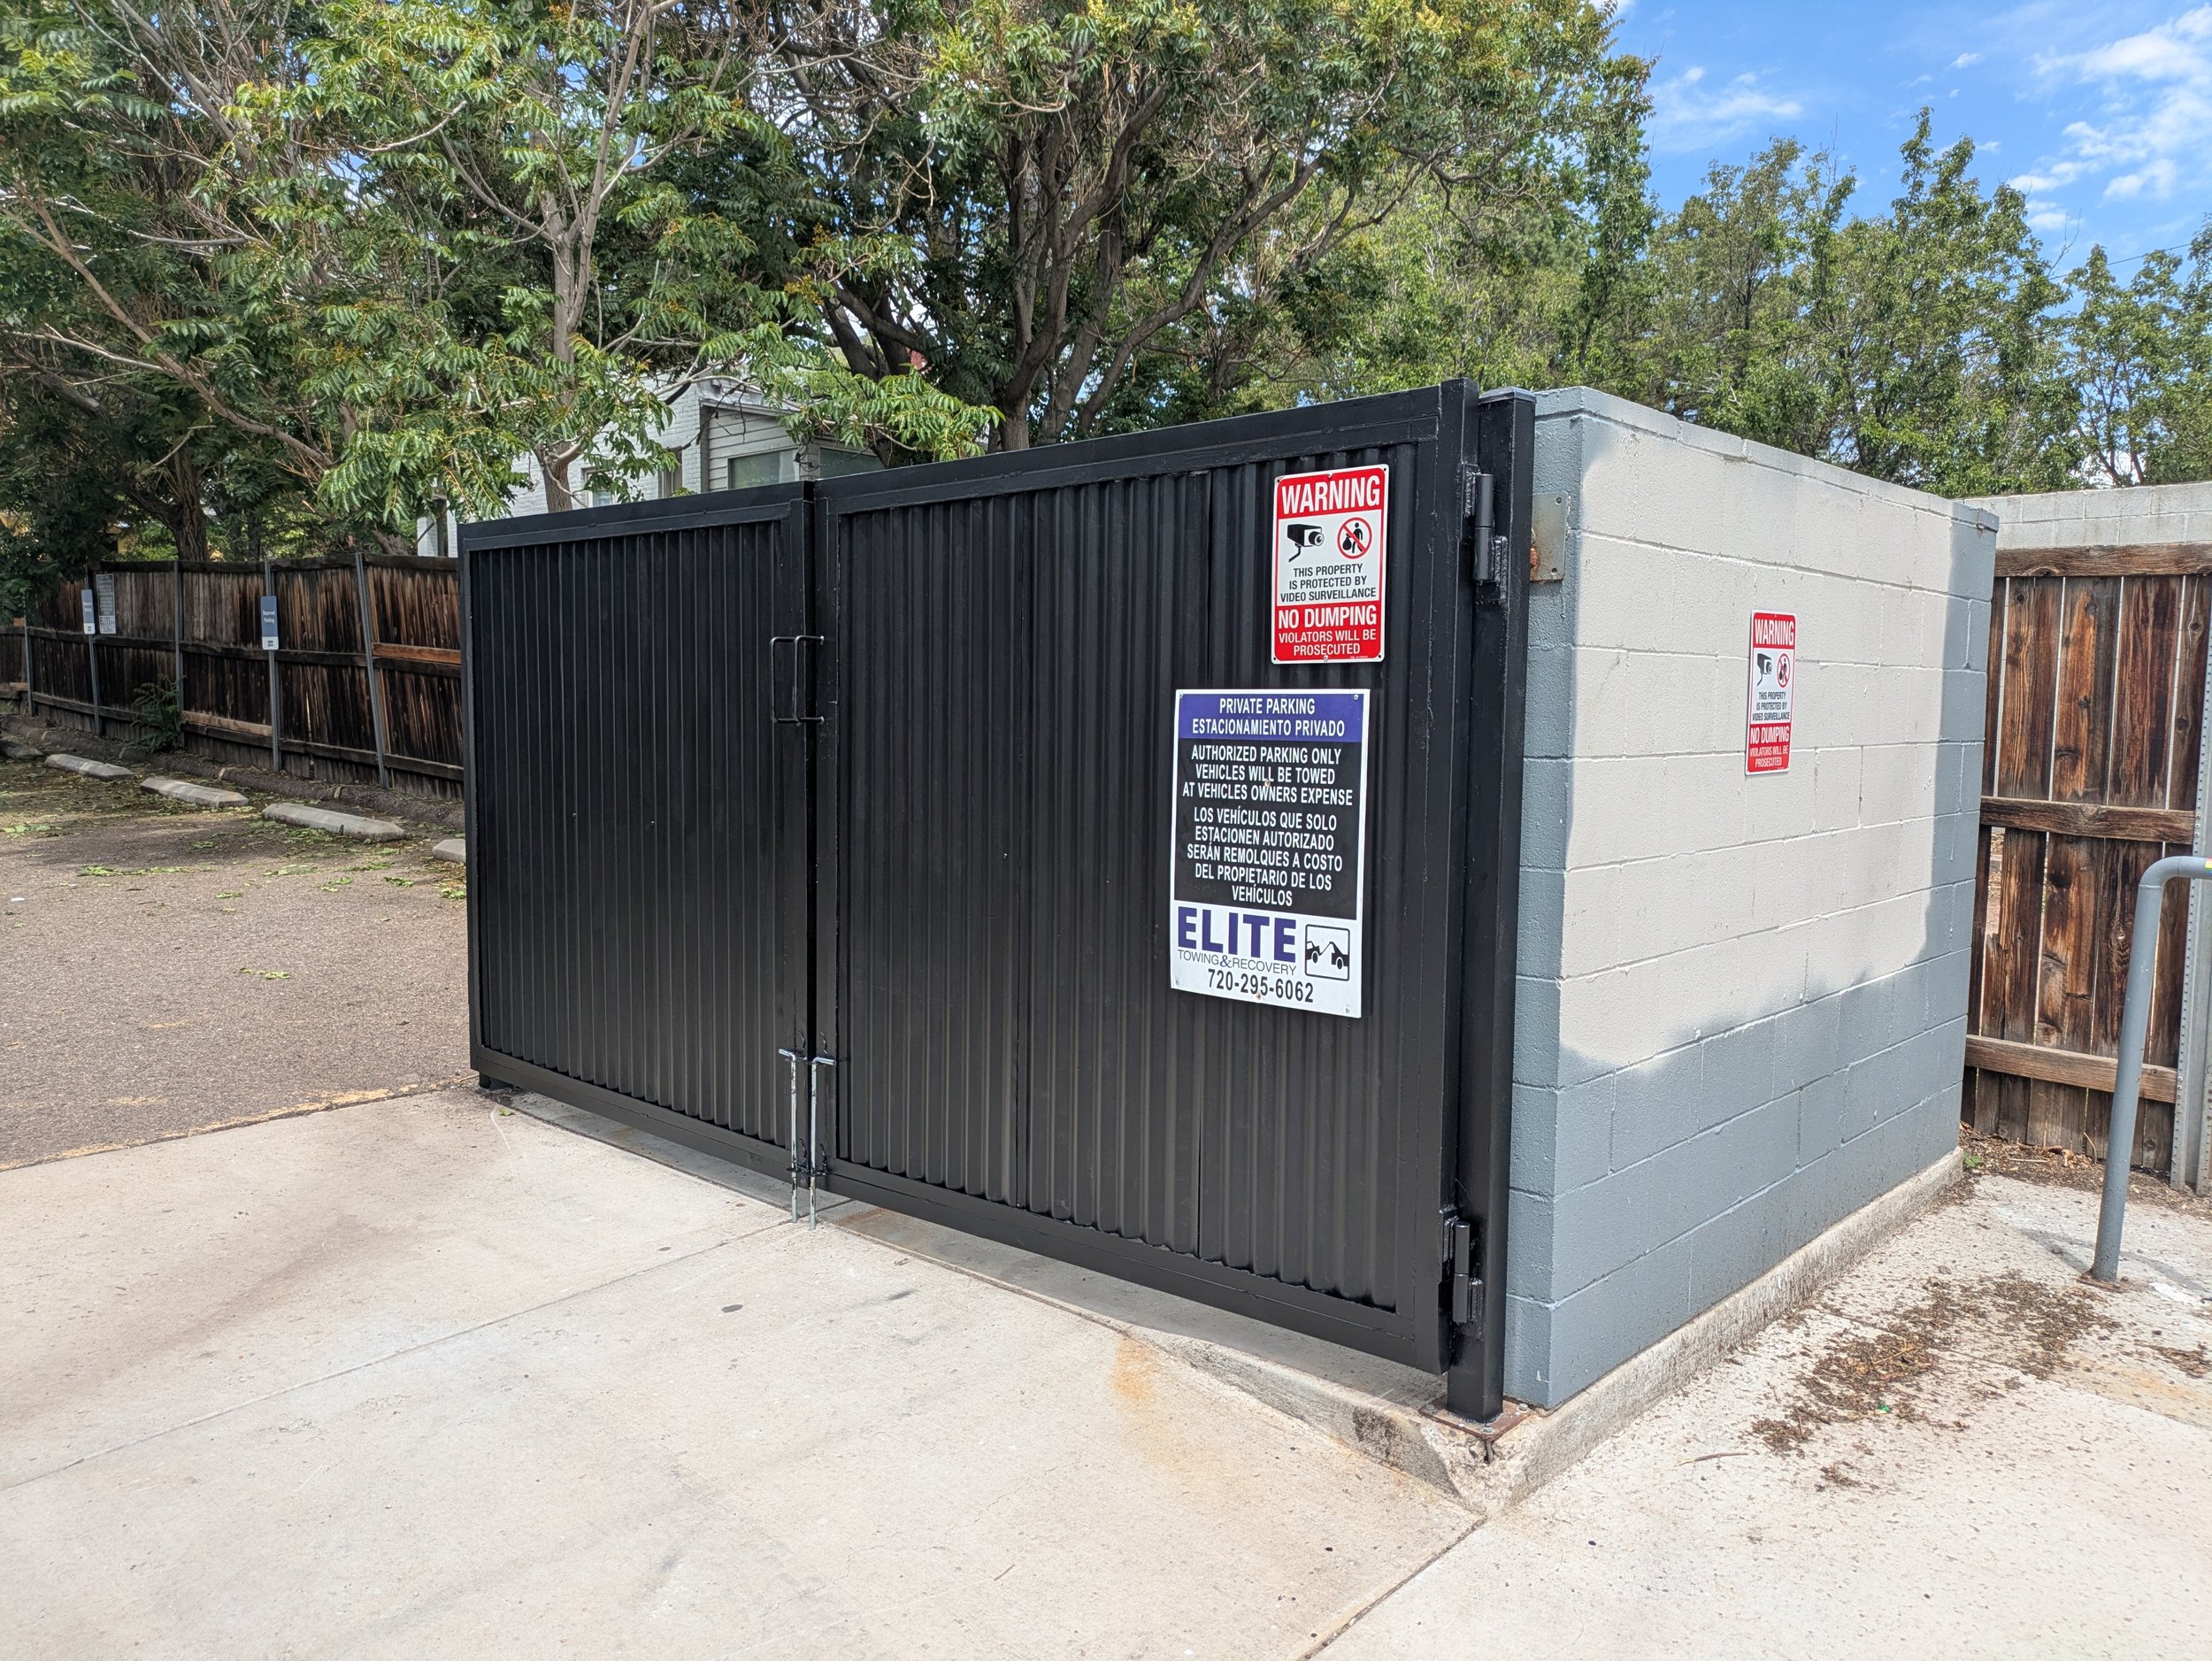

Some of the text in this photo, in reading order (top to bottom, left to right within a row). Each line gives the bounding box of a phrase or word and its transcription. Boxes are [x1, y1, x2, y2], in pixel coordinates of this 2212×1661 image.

[1281, 475, 1380, 514] WARNING
[1294, 563, 1363, 577] THIS PROPERTY
[1289, 575, 1367, 589] IS PROTECTED BY
[1280, 588, 1377, 602] VIDEO SURVEILLANCE
[1279, 605, 1377, 629] NO DUMPING
[1279, 629, 1377, 643] VIOLATORS WILL BE
[1755, 619, 1794, 646] WARNING
[1294, 643, 1360, 656] PROSECUTED
[1219, 697, 1315, 715] PRIVATE PARKING
[1193, 719, 1345, 736] ESTACIONAMIENTO PRIVADO
[1750, 726, 1789, 744] NO DUMPING
[1191, 745, 1341, 765] AUTHORIZED PARKING ONLY
[1750, 747, 1771, 757] VIOLATORS
[1783, 745, 1788, 754] BE
[1755, 757, 1782, 767] PROSECUTED
[1196, 764, 1335, 785] VEHICLES WILL BE TOWED
[1182, 782, 1353, 805] AT VEHICLES OWNERS EXPENSE
[1194, 806, 1337, 831] LOS VEHÍCULOS QUE SOLO
[1195, 826, 1334, 851] ESTACIONEN AUTORIZADO
[1187, 842, 1342, 872] SERÁN REMOLQUES A COSTO
[1195, 863, 1332, 891] DEL PROPIETARIO DE LOS
[1232, 885, 1293, 906] VEHÍCULOS
[1179, 906, 1296, 963] ELITE
[1178, 950, 1297, 975] TOWING&RECOVERY
[1209, 969, 1313, 1004] 720-295-6062
